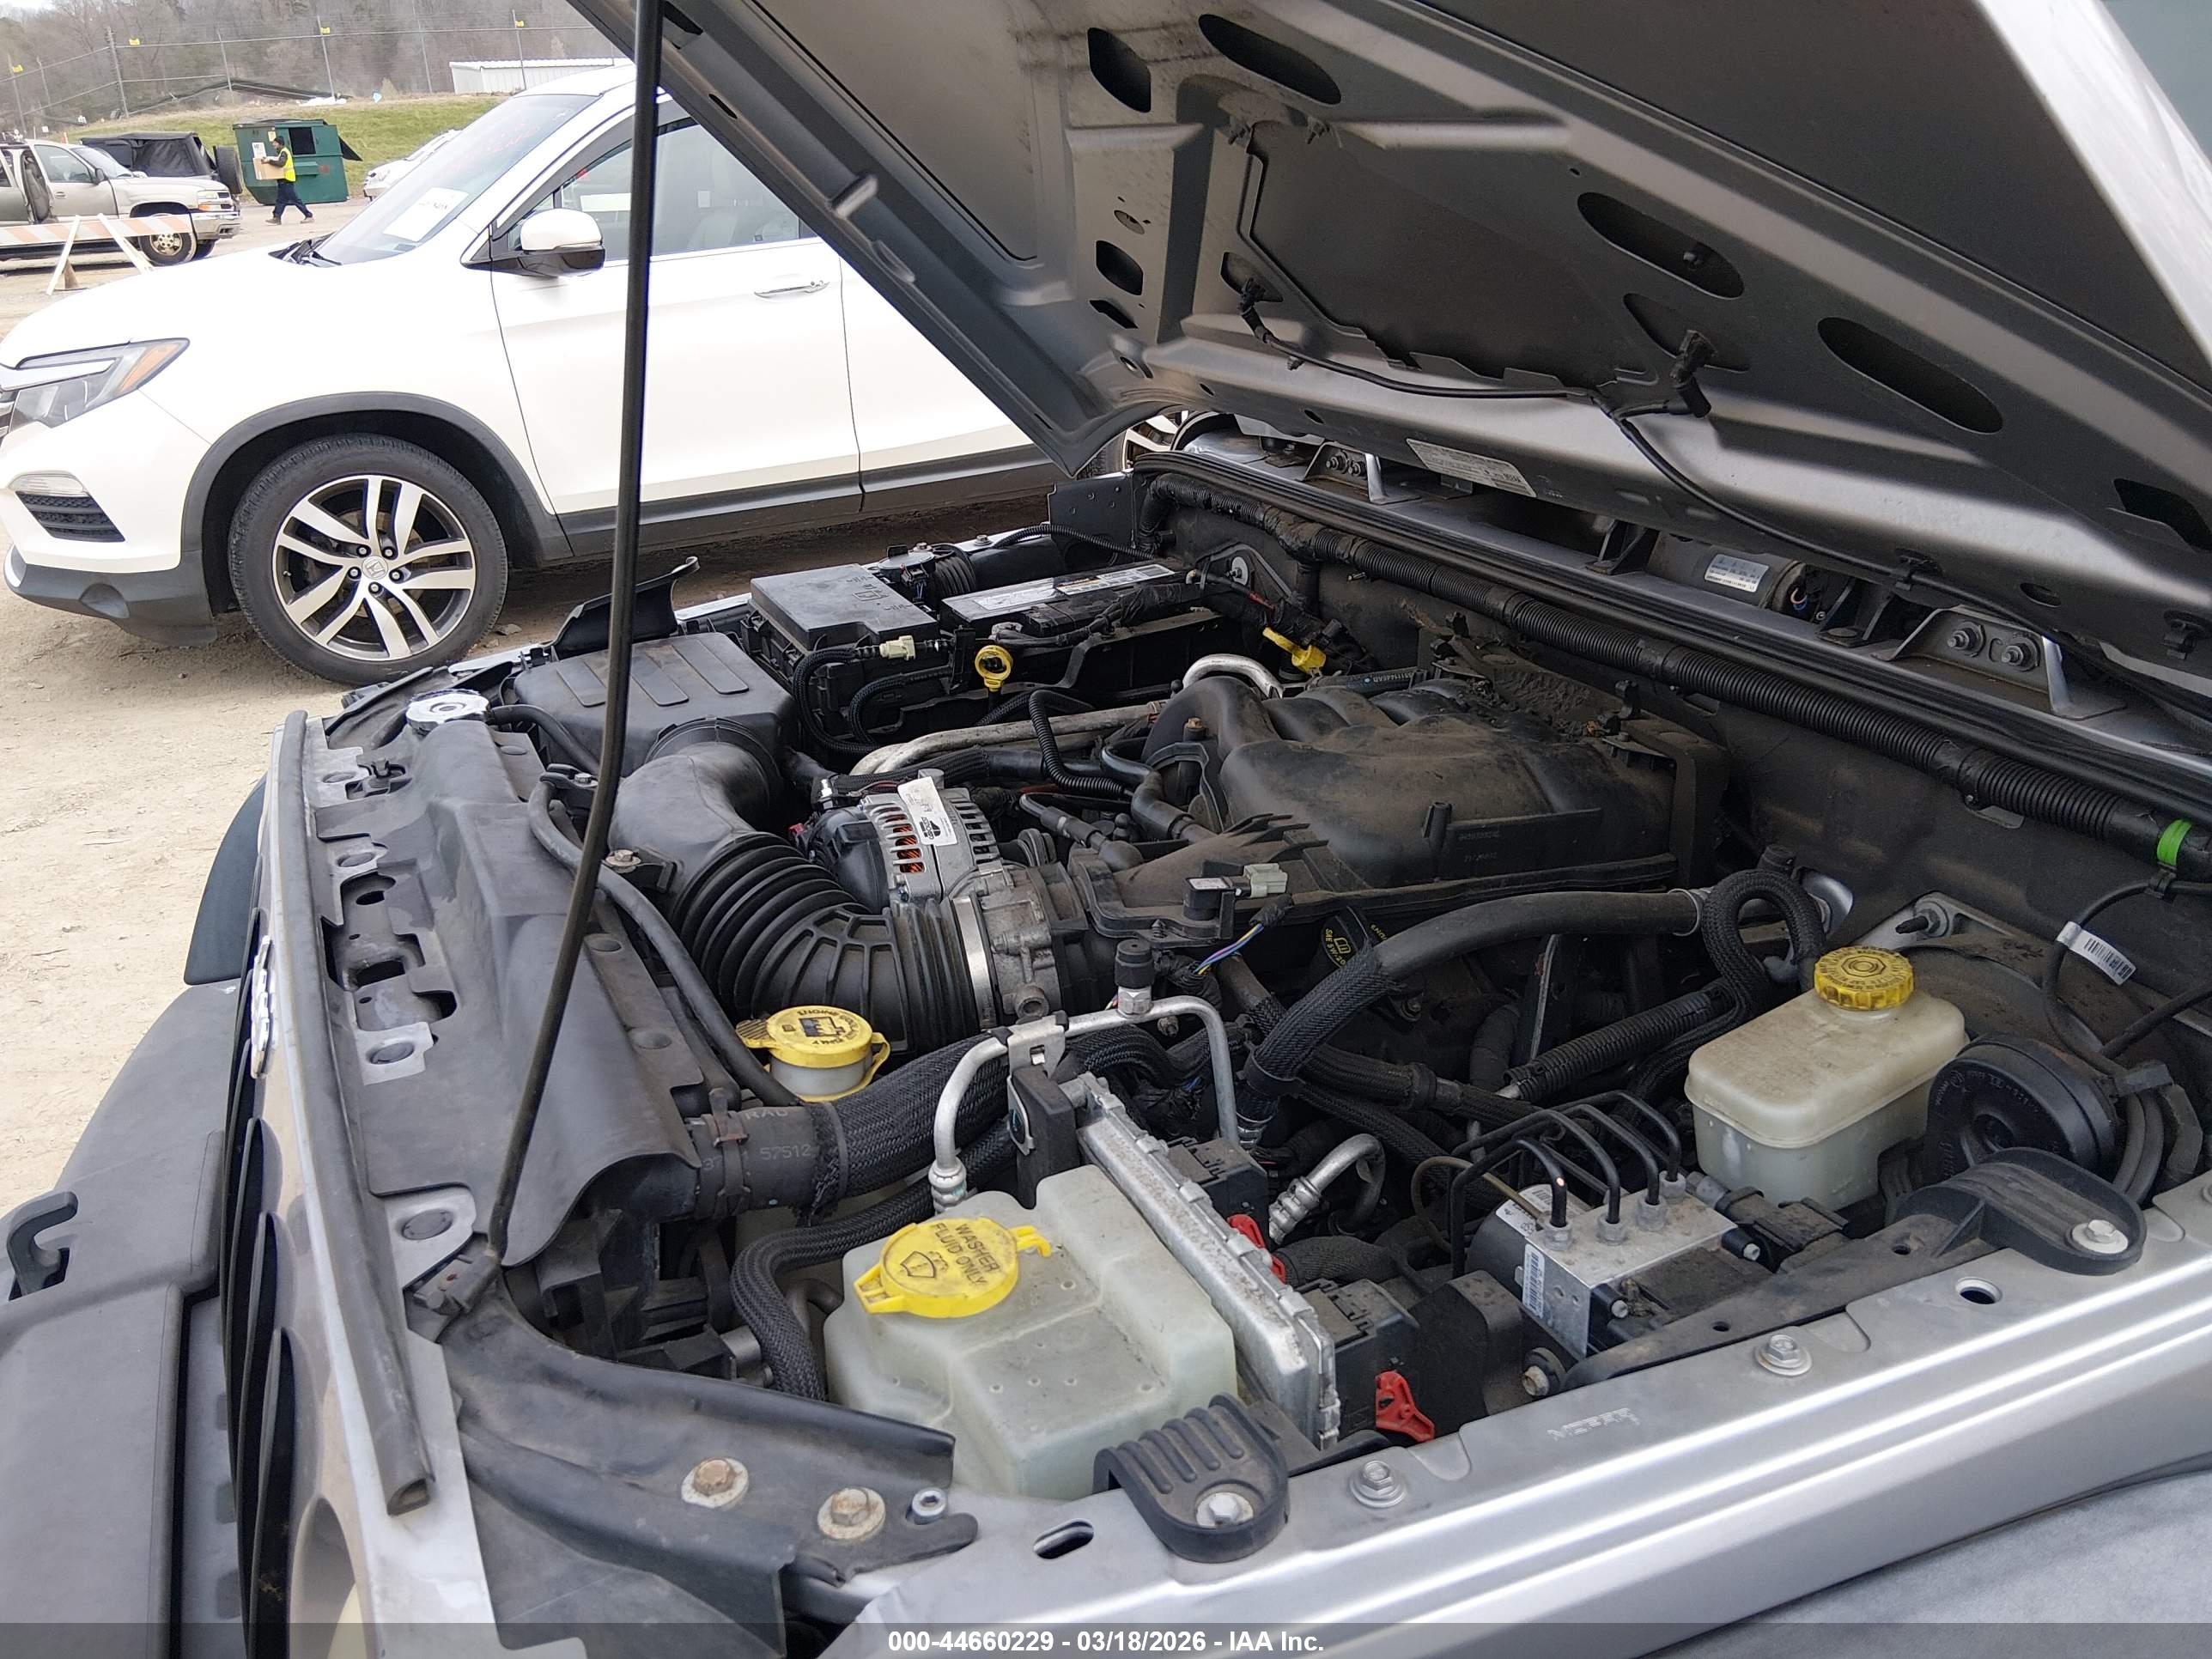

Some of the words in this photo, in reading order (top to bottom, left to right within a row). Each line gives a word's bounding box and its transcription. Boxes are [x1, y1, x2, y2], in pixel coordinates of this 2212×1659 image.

[1325, 928, 1334, 943] SAE
[760, 1144, 811, 1161] 57512
[933, 1222, 963, 1255] FLUID
[956, 1255, 988, 1285] ONLY
[955, 1223, 1000, 1273] WASHER
